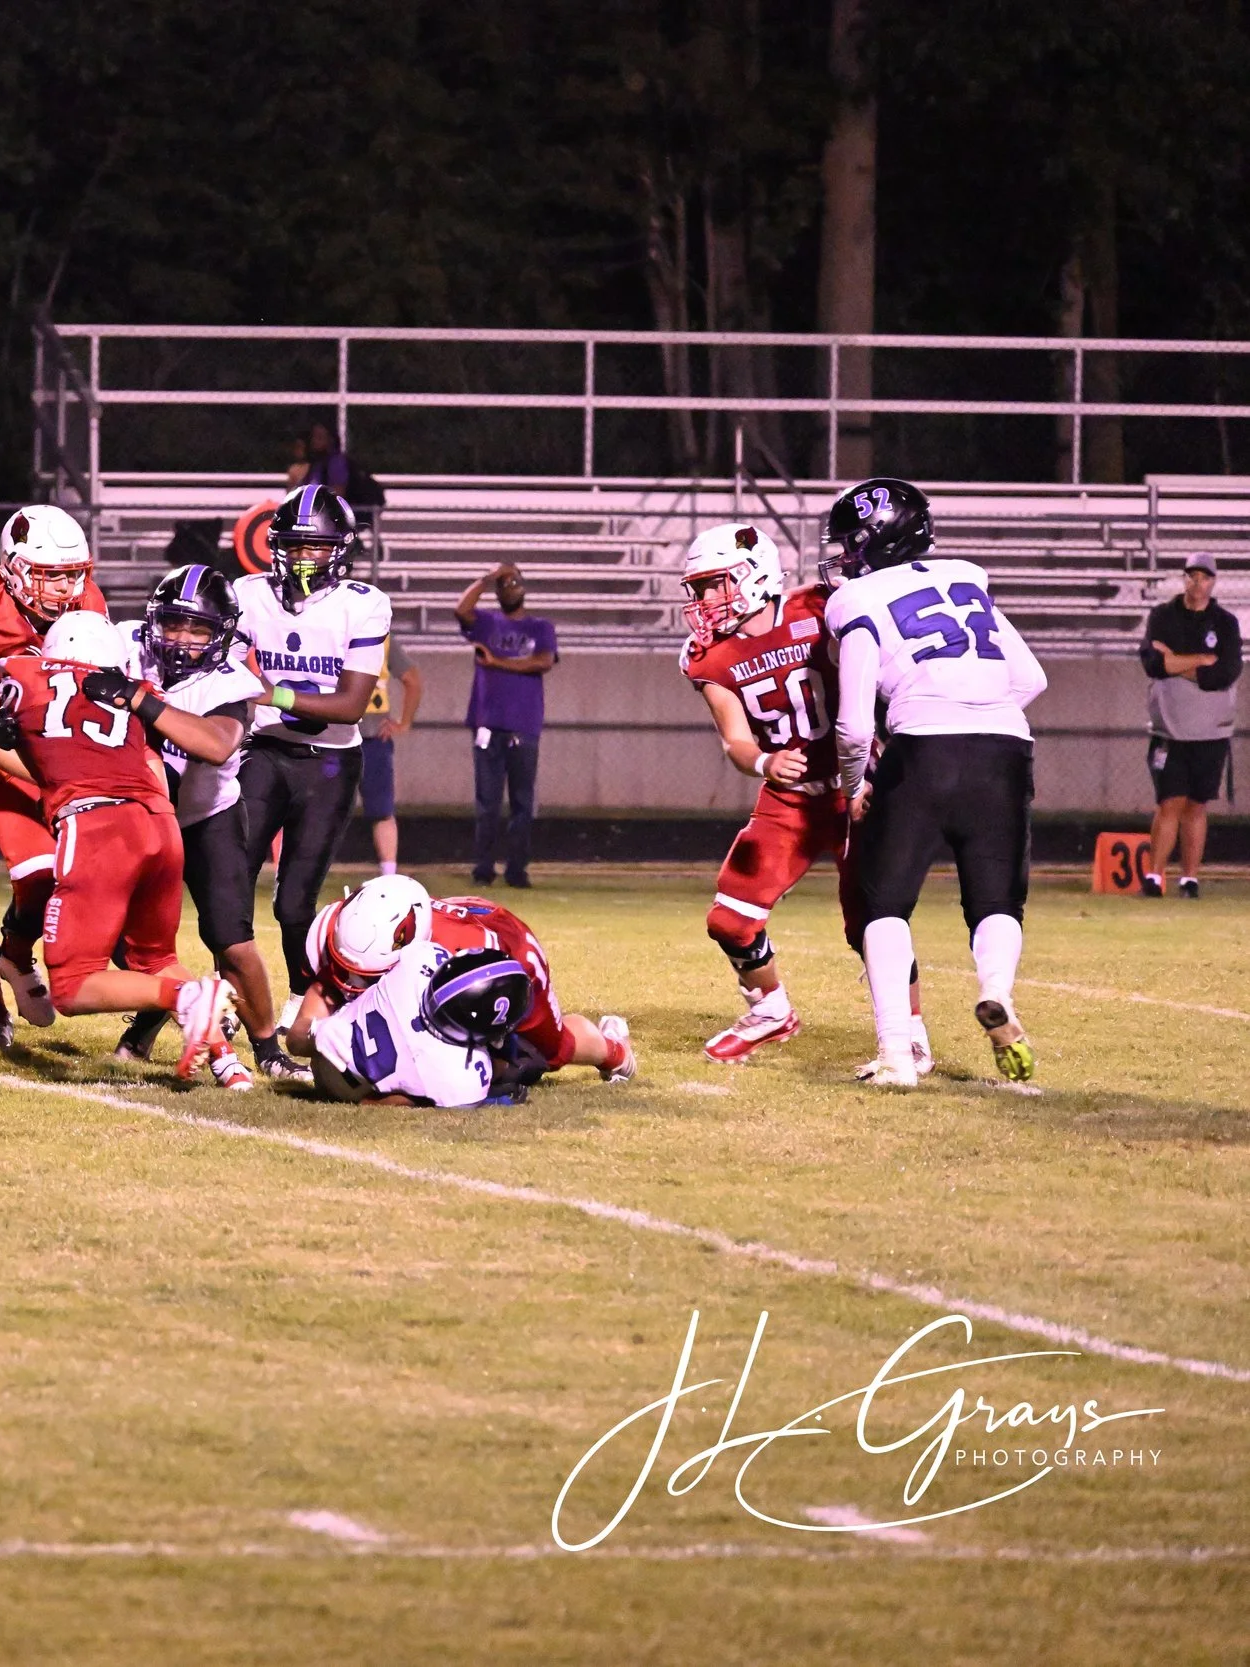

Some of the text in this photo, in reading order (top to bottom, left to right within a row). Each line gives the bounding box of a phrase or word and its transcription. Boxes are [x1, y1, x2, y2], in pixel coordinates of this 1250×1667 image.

[854, 487, 892, 518] 52
[886, 582, 1007, 665] 52
[729, 642, 812, 683] MILLINGTON
[739, 666, 830, 745] 50
[43, 897, 63, 944] CARDS
[491, 996, 510, 1025] 2
[474, 1060, 489, 1088] 2
